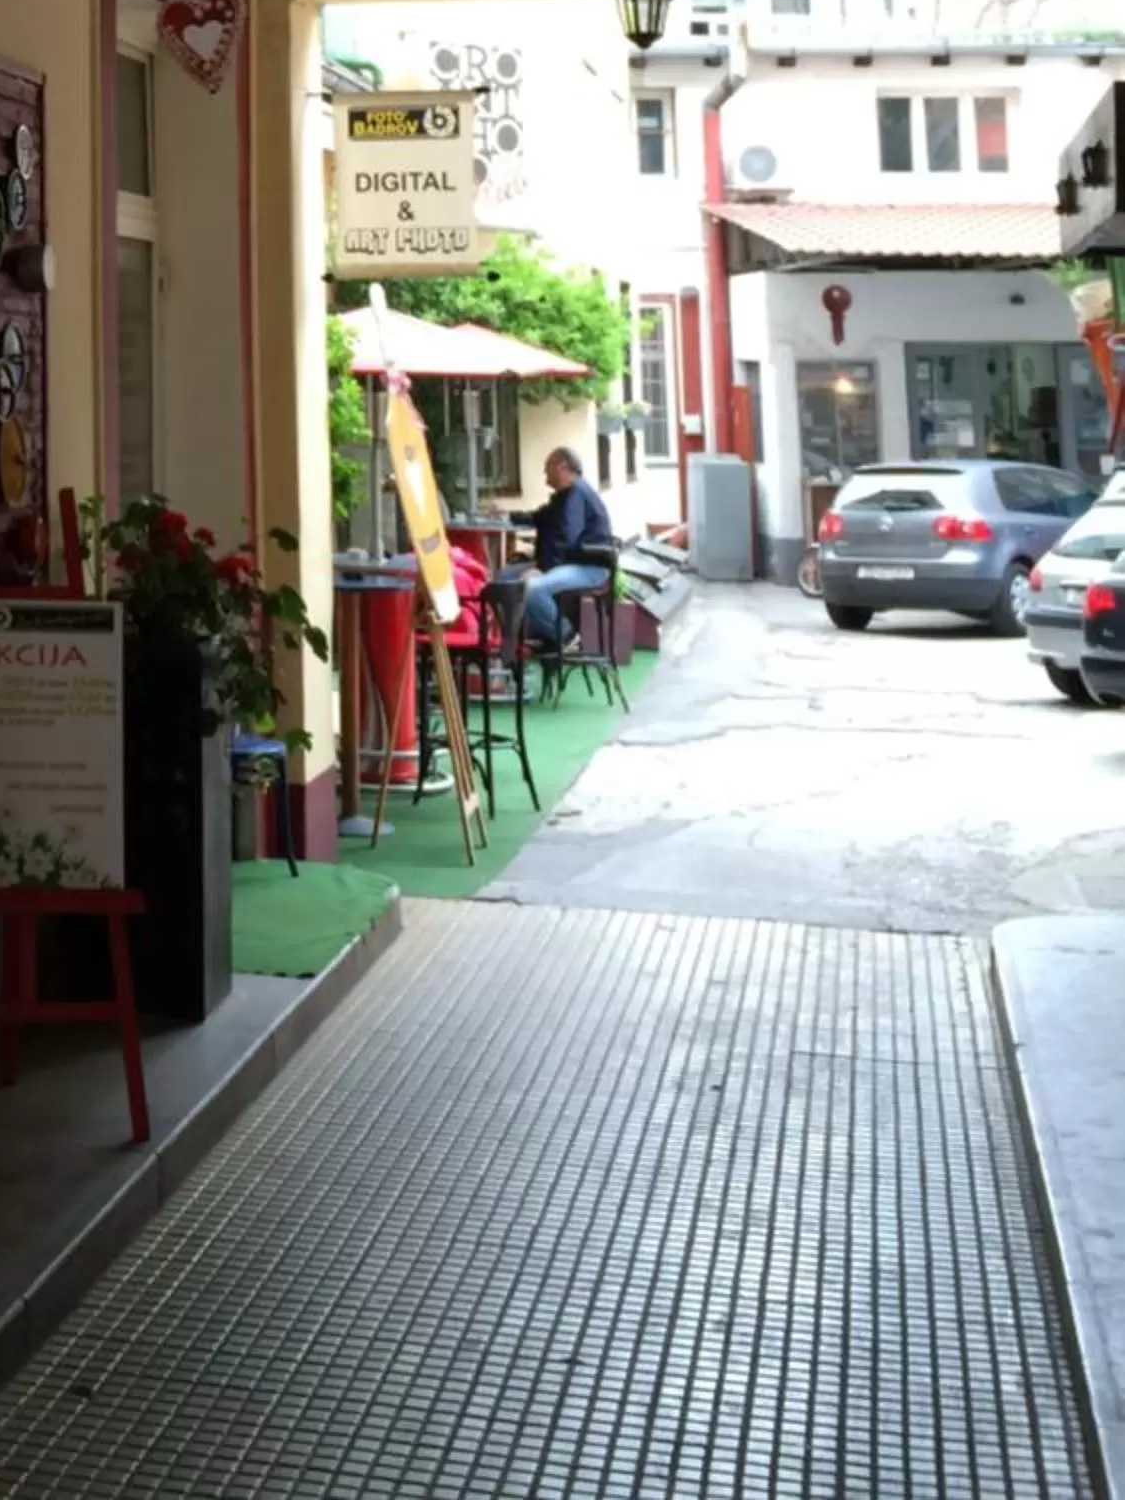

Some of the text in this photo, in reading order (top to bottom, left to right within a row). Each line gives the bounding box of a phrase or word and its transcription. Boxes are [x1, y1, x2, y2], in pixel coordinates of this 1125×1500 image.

[366, 110, 405, 122] FOTO
[355, 171, 457, 193] DIGITAL
[397, 200, 415, 221] &
[344, 226, 470, 255] ART PHOTO
